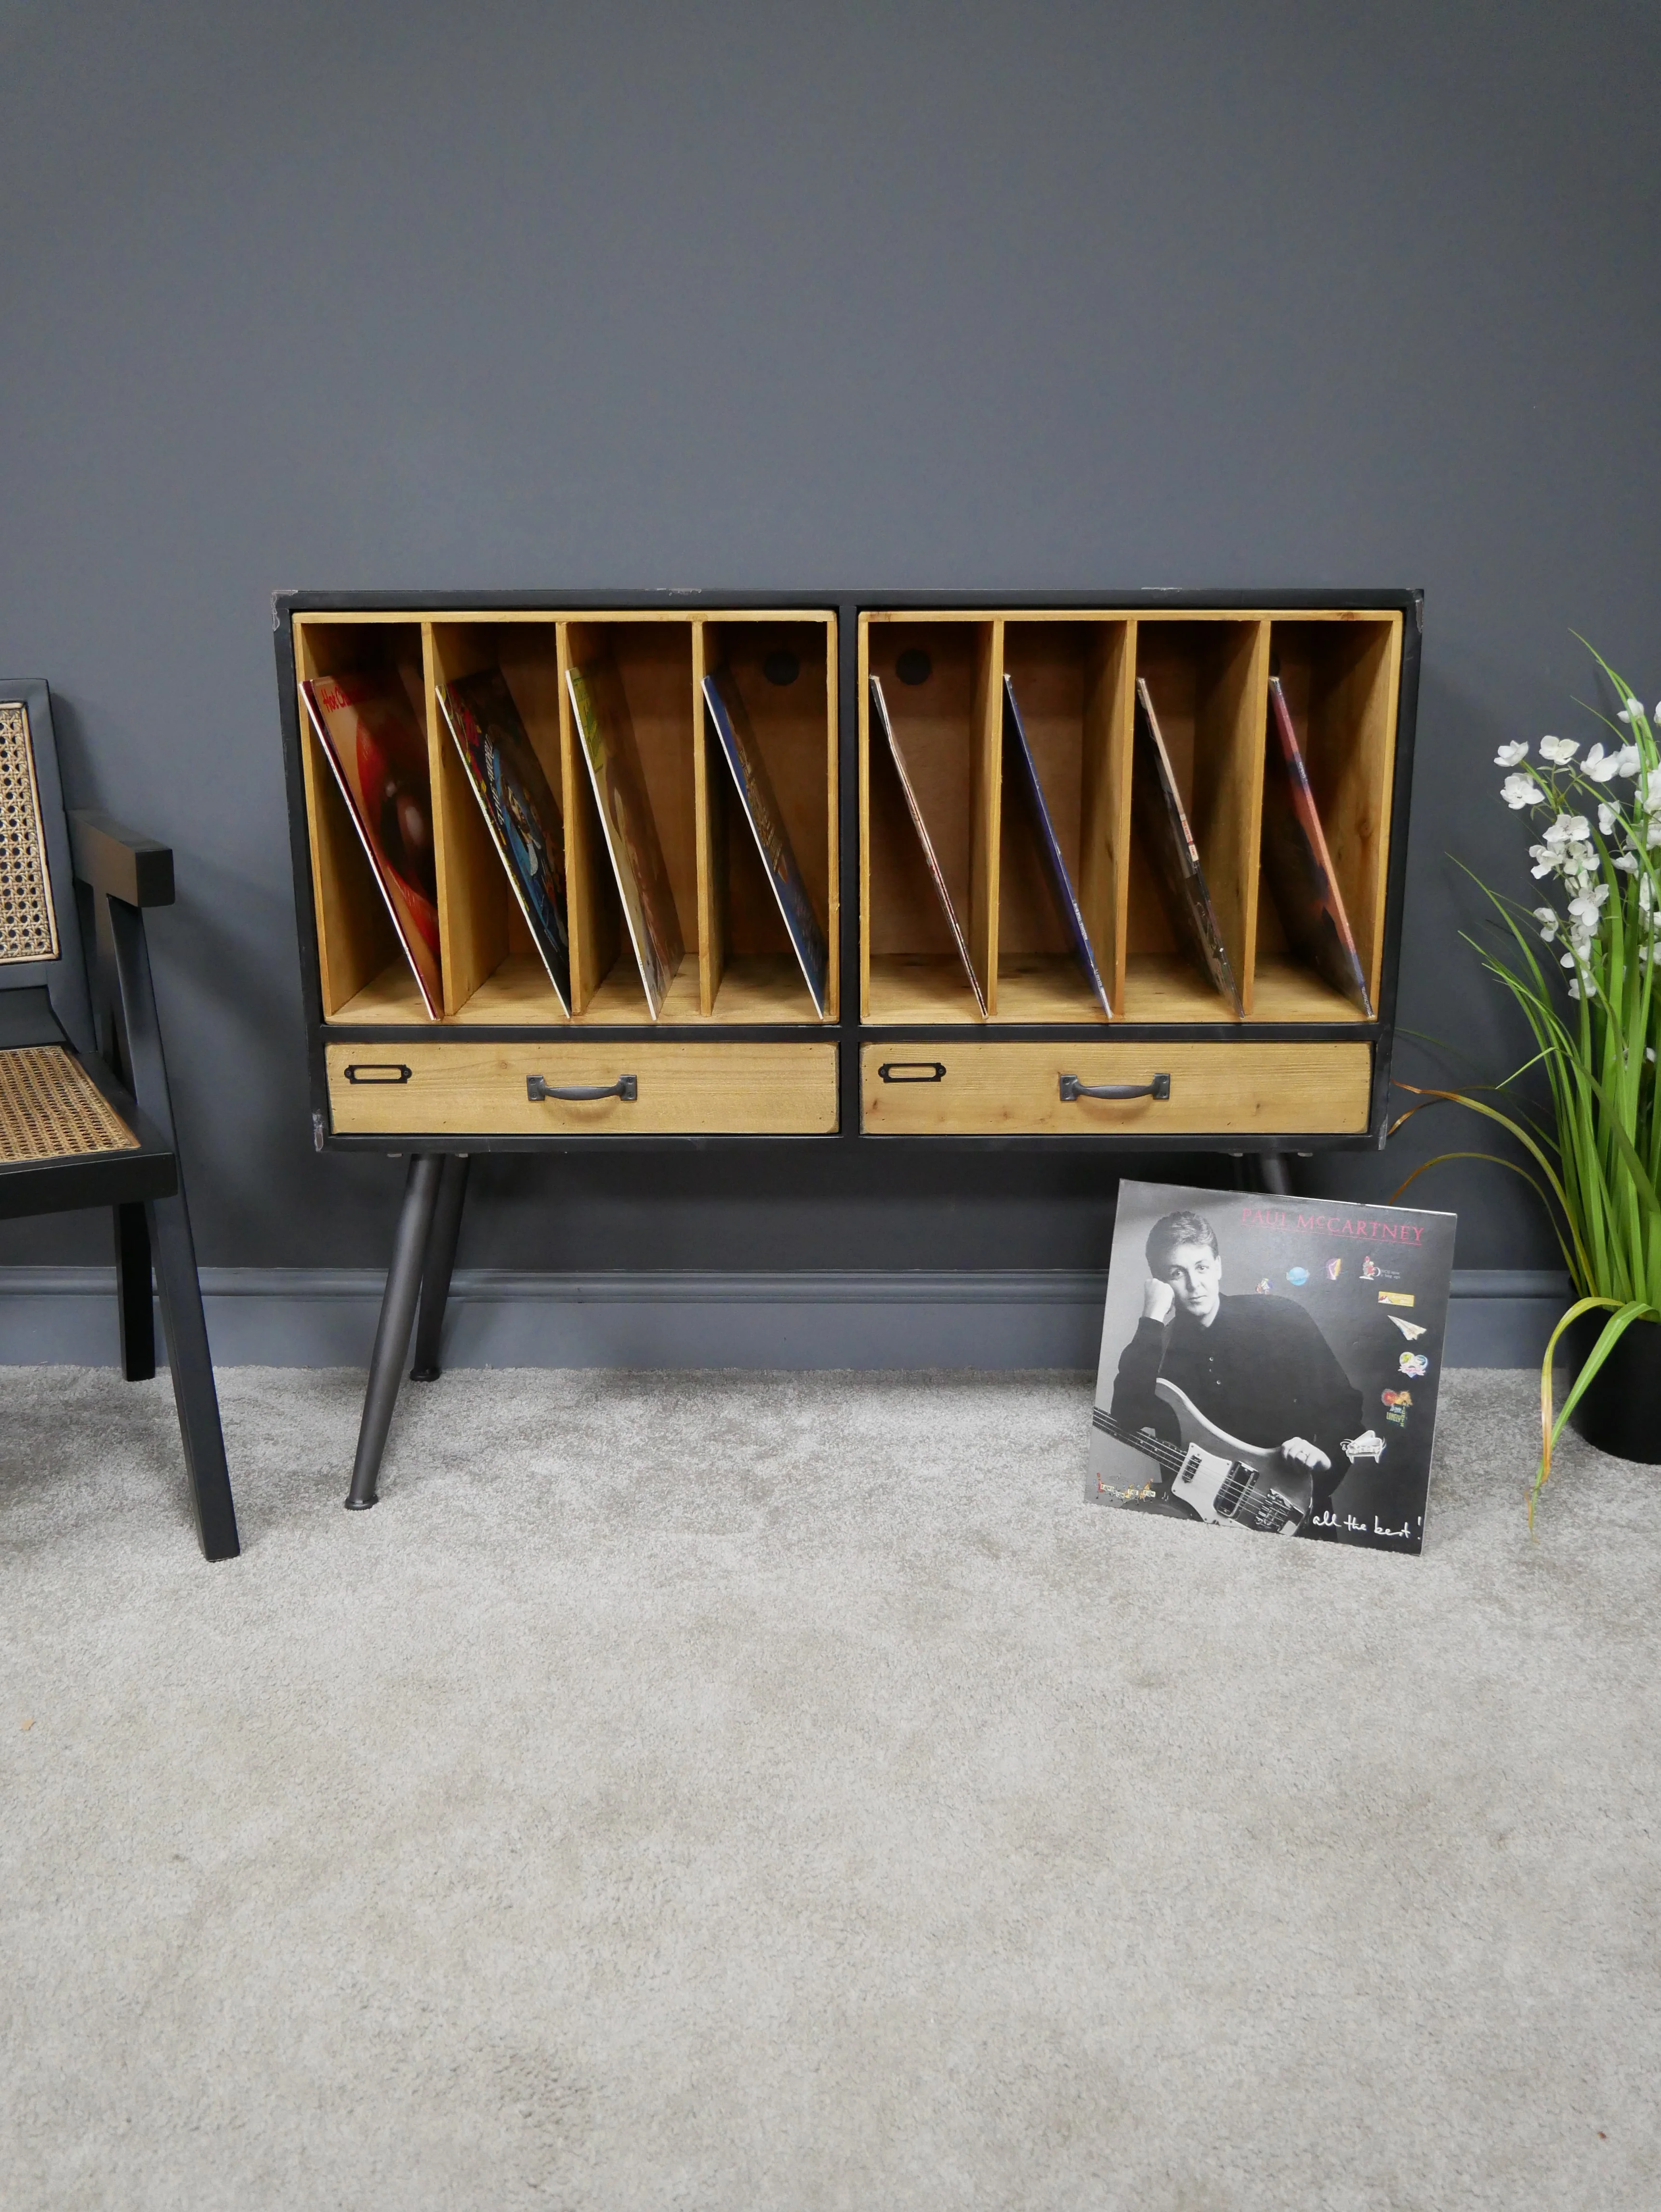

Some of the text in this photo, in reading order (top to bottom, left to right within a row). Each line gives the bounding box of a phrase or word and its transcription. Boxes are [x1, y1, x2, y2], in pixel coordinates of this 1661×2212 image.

[1242, 1208, 1287, 1226] PAUL
[1313, 1511, 1341, 1526] all
[1344, 1514, 1367, 1531] the
